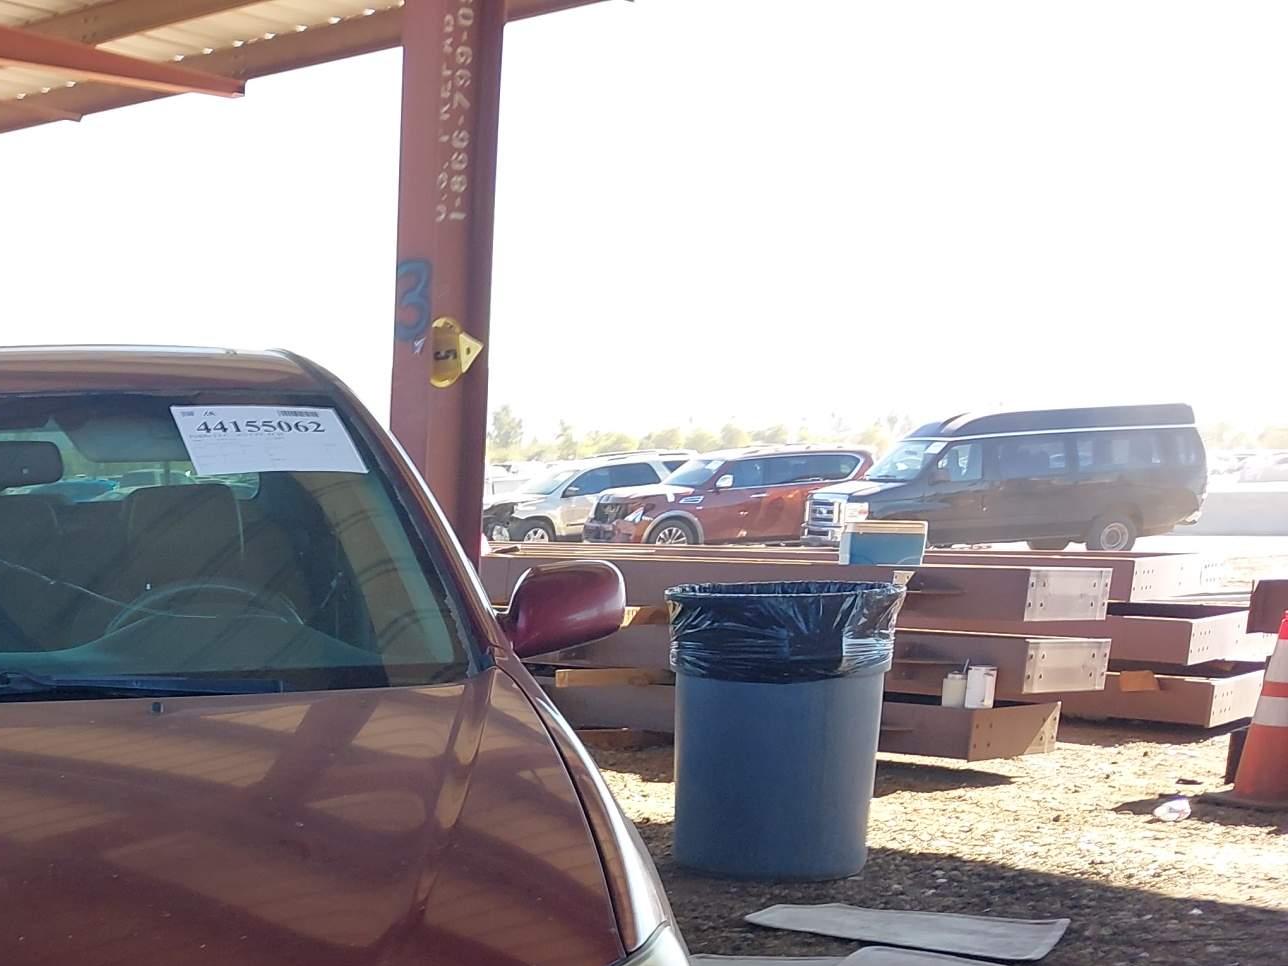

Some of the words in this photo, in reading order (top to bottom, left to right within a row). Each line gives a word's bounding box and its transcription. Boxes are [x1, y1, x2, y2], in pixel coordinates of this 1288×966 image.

[449, 0, 474, 221] 1-866-799-0
[397, 258, 430, 343] 3
[196, 420, 326, 434] 44155062
